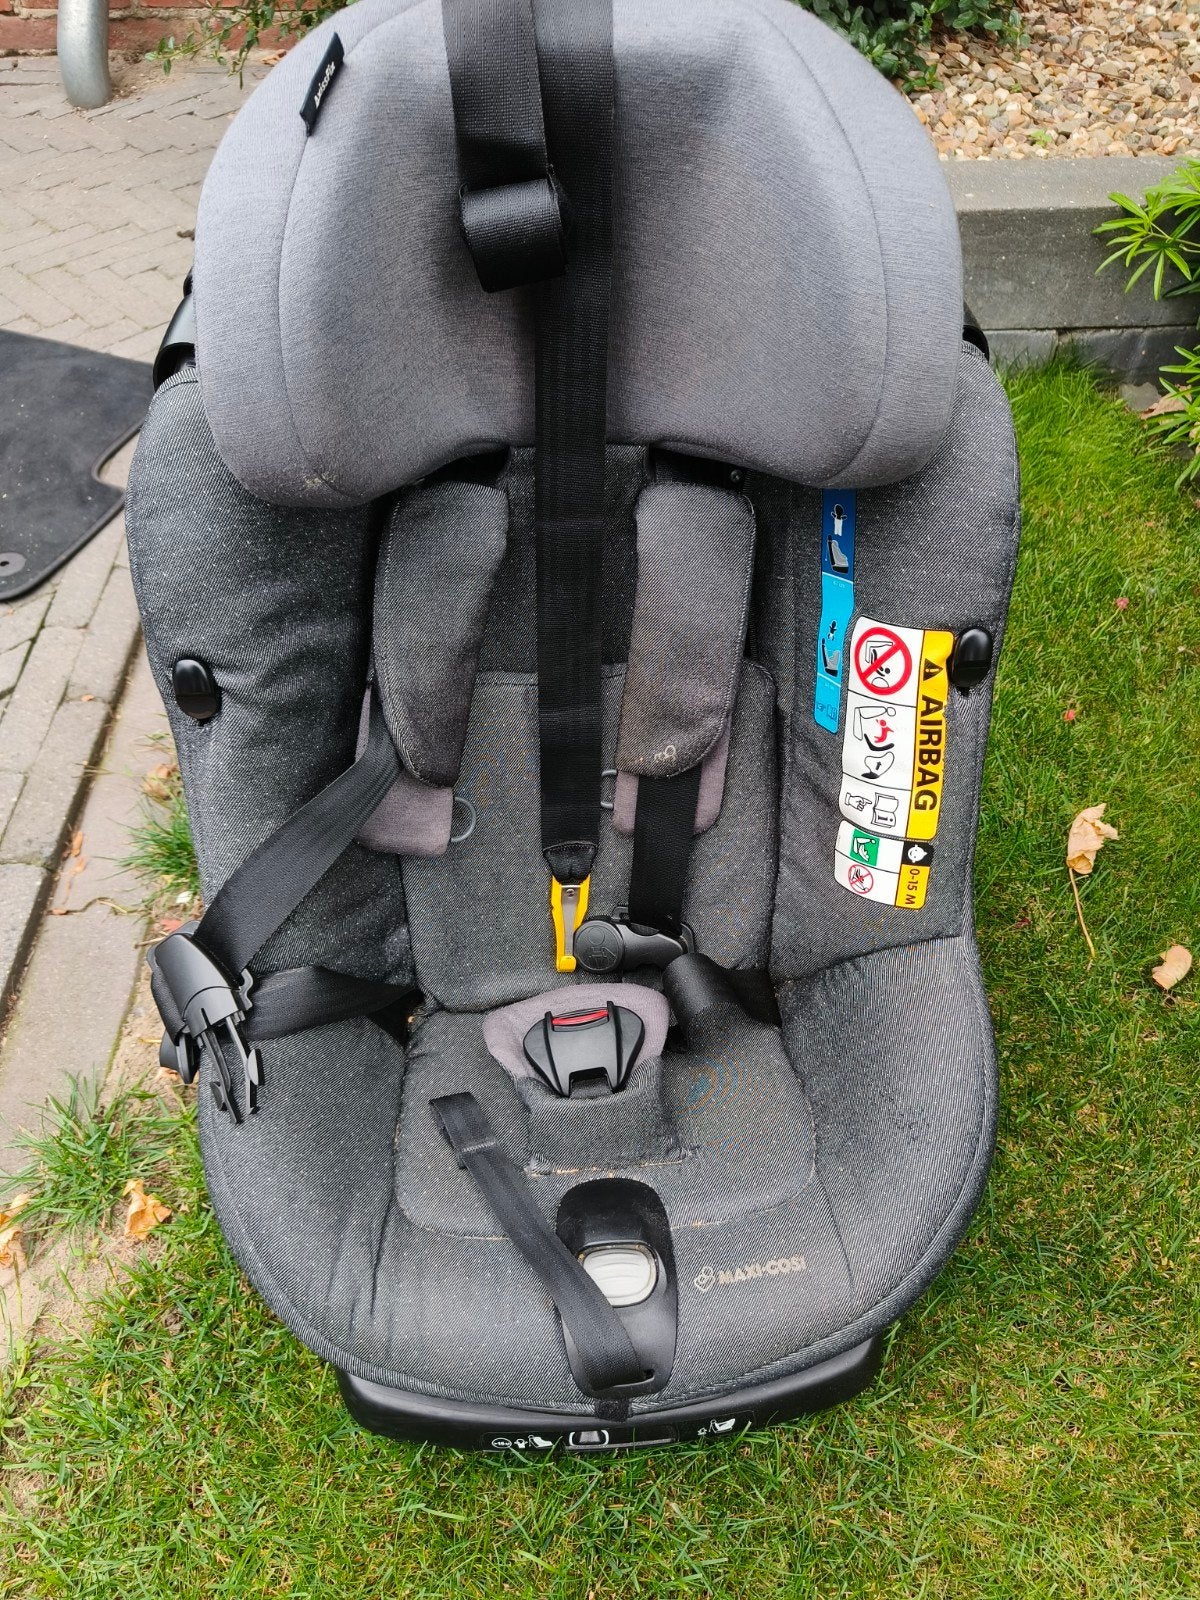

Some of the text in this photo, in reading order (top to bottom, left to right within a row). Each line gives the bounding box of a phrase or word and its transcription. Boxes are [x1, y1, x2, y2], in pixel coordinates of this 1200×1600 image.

[914, 694, 943, 811] AIRBAG
[905, 868, 920, 905] 0-15 M
[718, 1254, 806, 1284] MAXI-COSI
